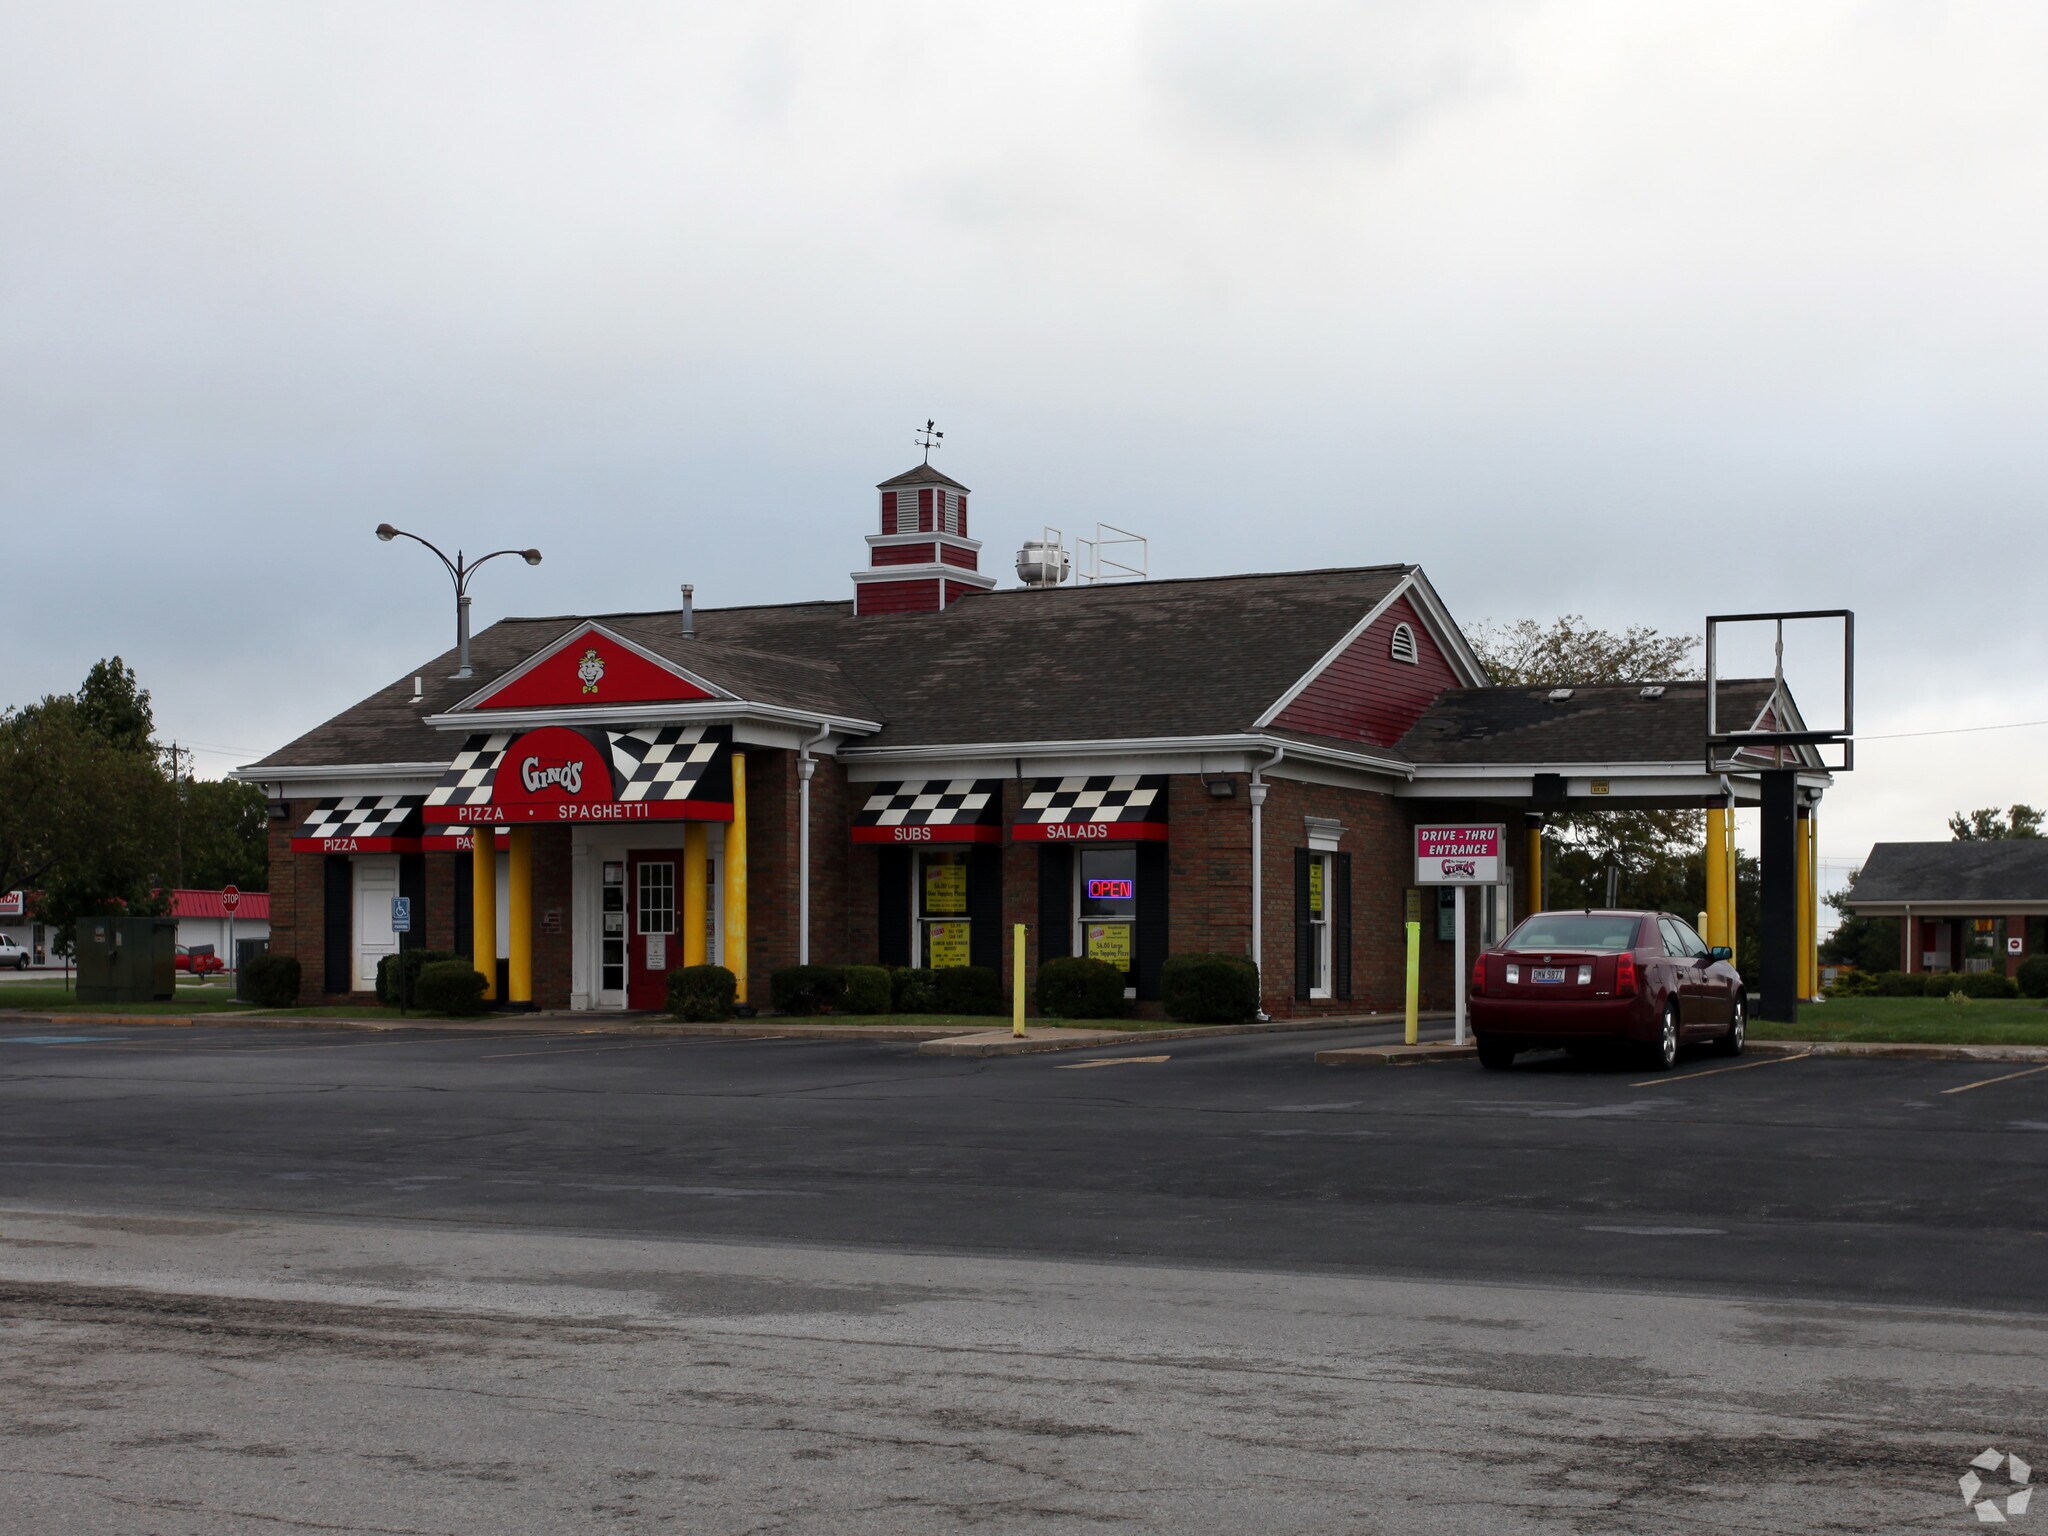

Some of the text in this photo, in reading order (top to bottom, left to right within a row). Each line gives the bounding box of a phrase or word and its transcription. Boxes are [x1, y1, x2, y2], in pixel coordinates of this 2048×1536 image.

[459, 804, 648, 821] PIZZA SPAGHETTI
[894, 827, 931, 841] SUBS
[1046, 824, 1108, 839] SALADS
[1421, 831, 1456, 841] DRIVE
[323, 839, 358, 851] PIZZA
[1429, 844, 1488, 855] ENTRANCE
[1091, 881, 1130, 896] OPEN
[0, 893, 19, 904] ICH
[223, 893, 239, 904] STOP
